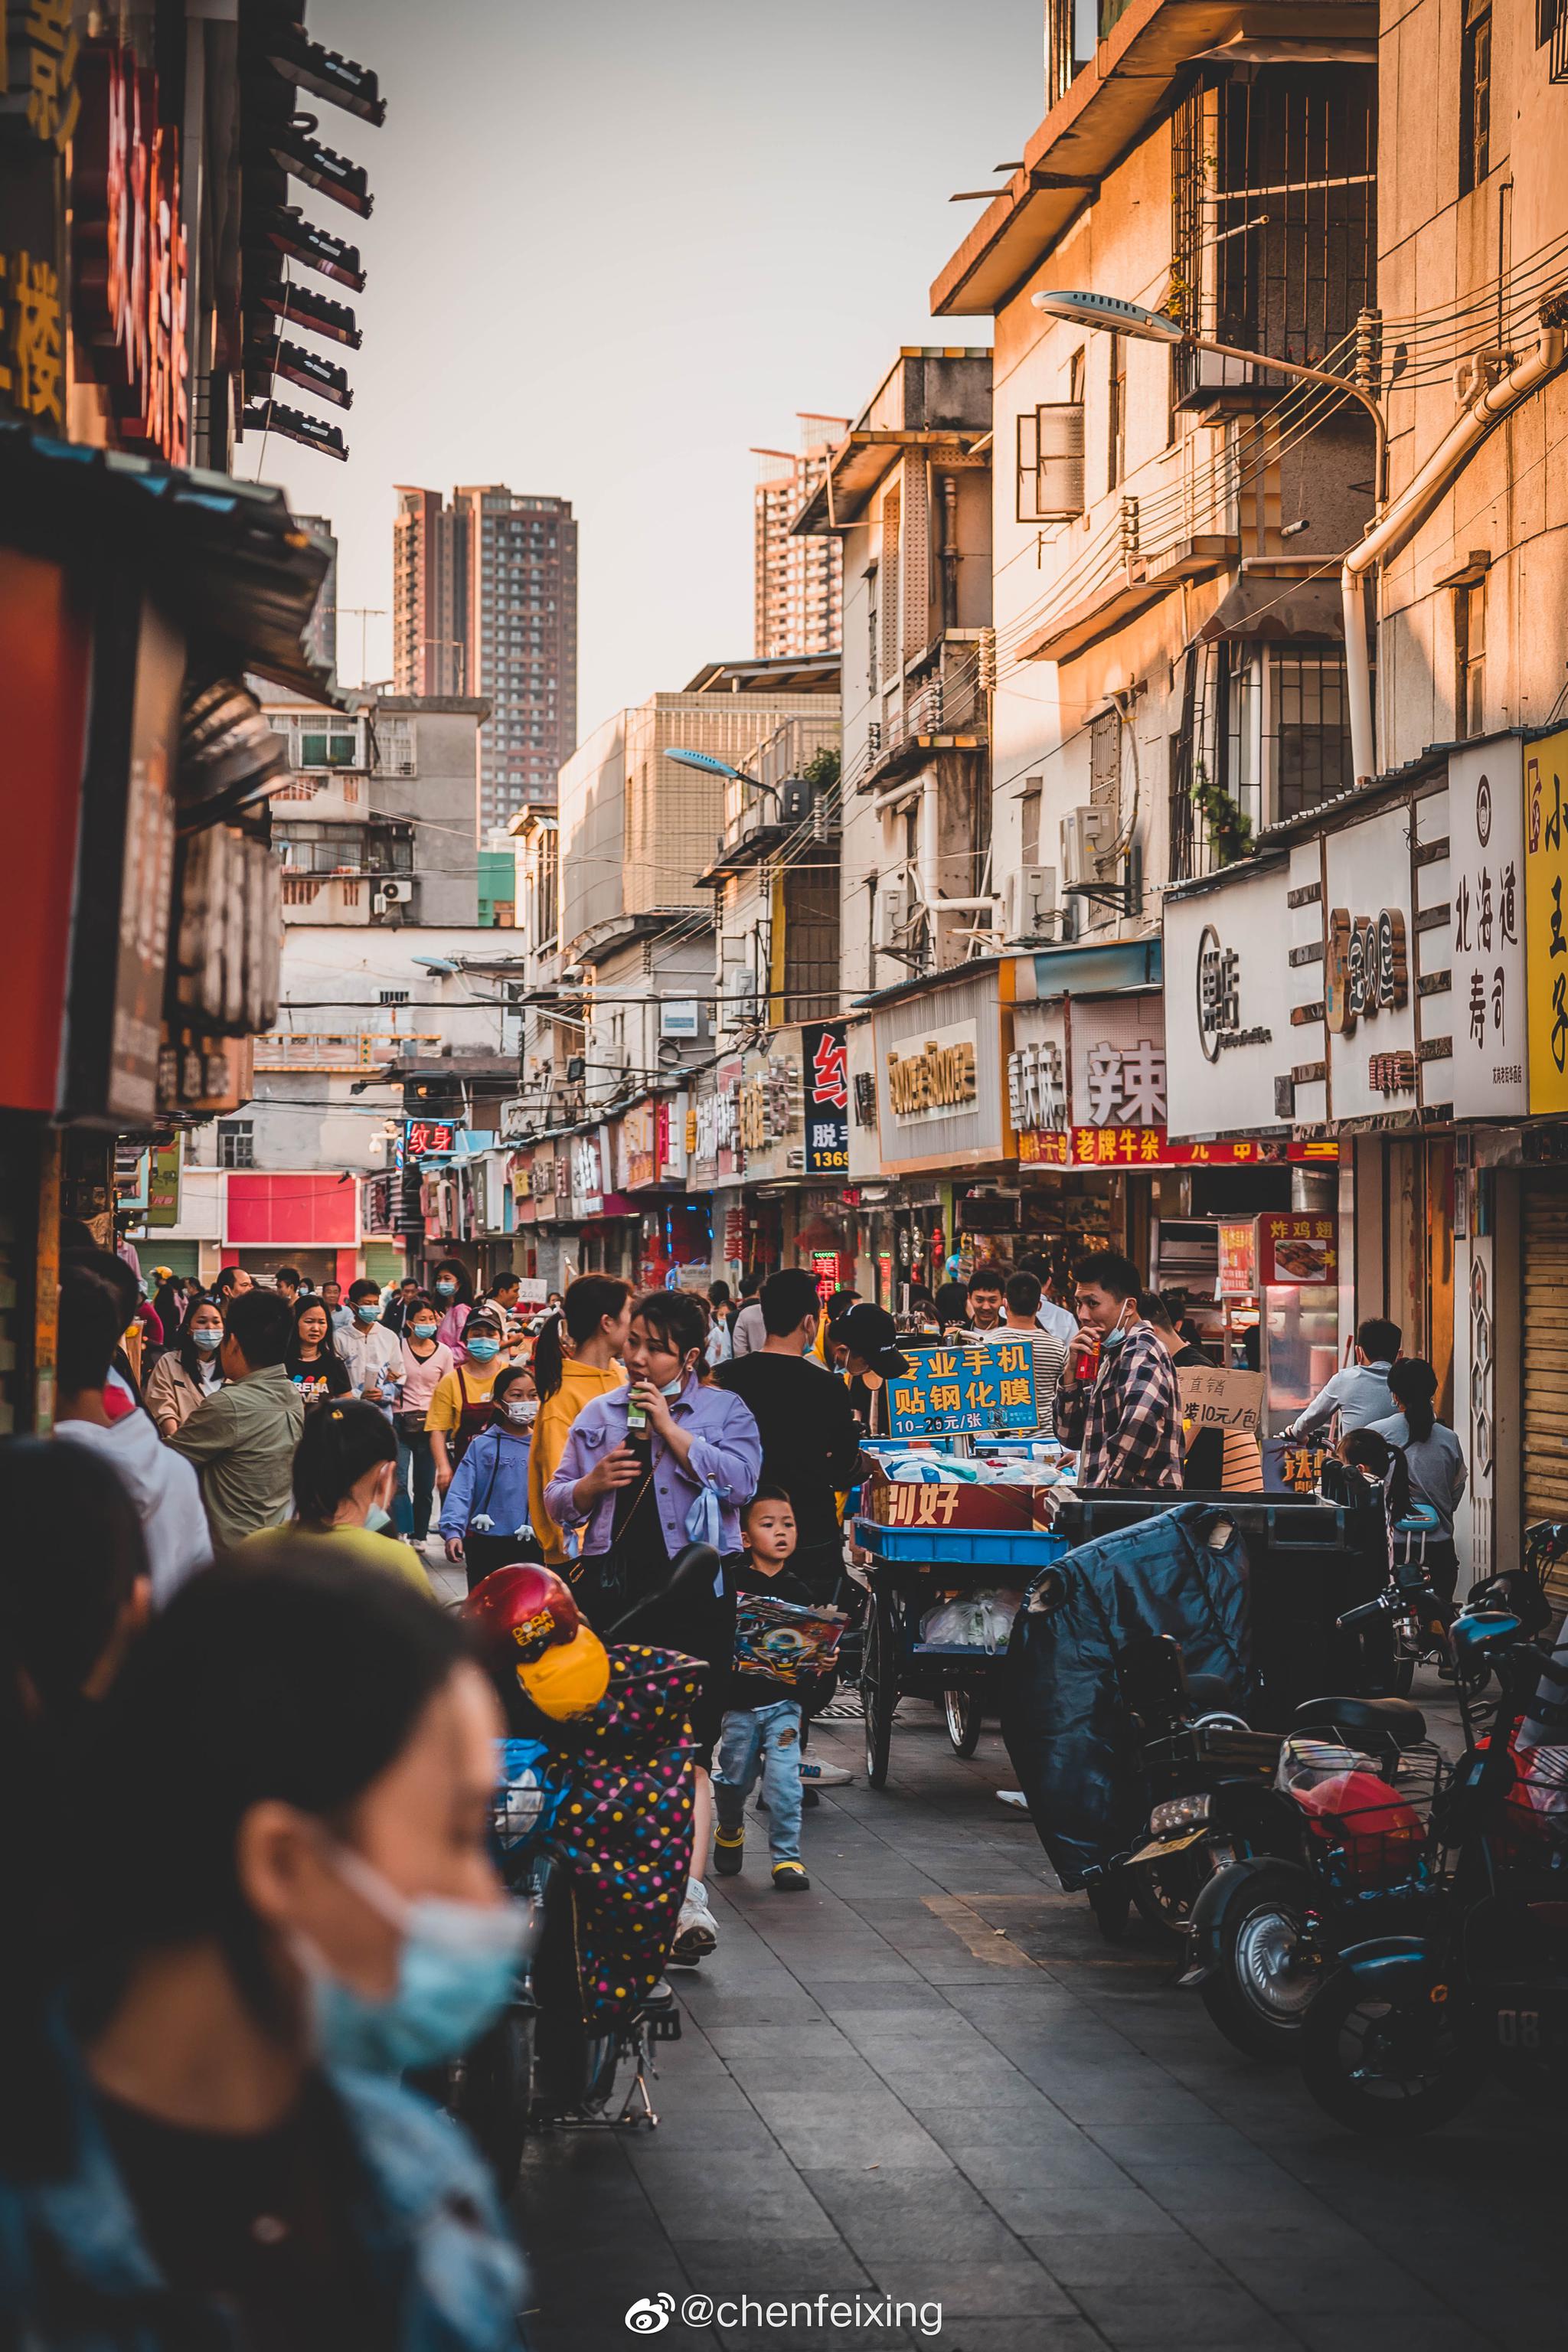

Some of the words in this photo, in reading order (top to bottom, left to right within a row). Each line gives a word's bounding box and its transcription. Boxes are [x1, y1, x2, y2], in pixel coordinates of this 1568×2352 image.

[1455, 860, 1518, 954] 北海道
[1468, 965, 1505, 1050] 寿司
[408, 1123, 452, 1154] 纹身
[1076, 1128, 1160, 1162] 老牌牛杂
[1270, 1220, 1334, 1239] 炸鸡翅
[899, 1344, 1031, 1381] 专业手机
[894, 1377, 1033, 1416] 贴钢化膜
